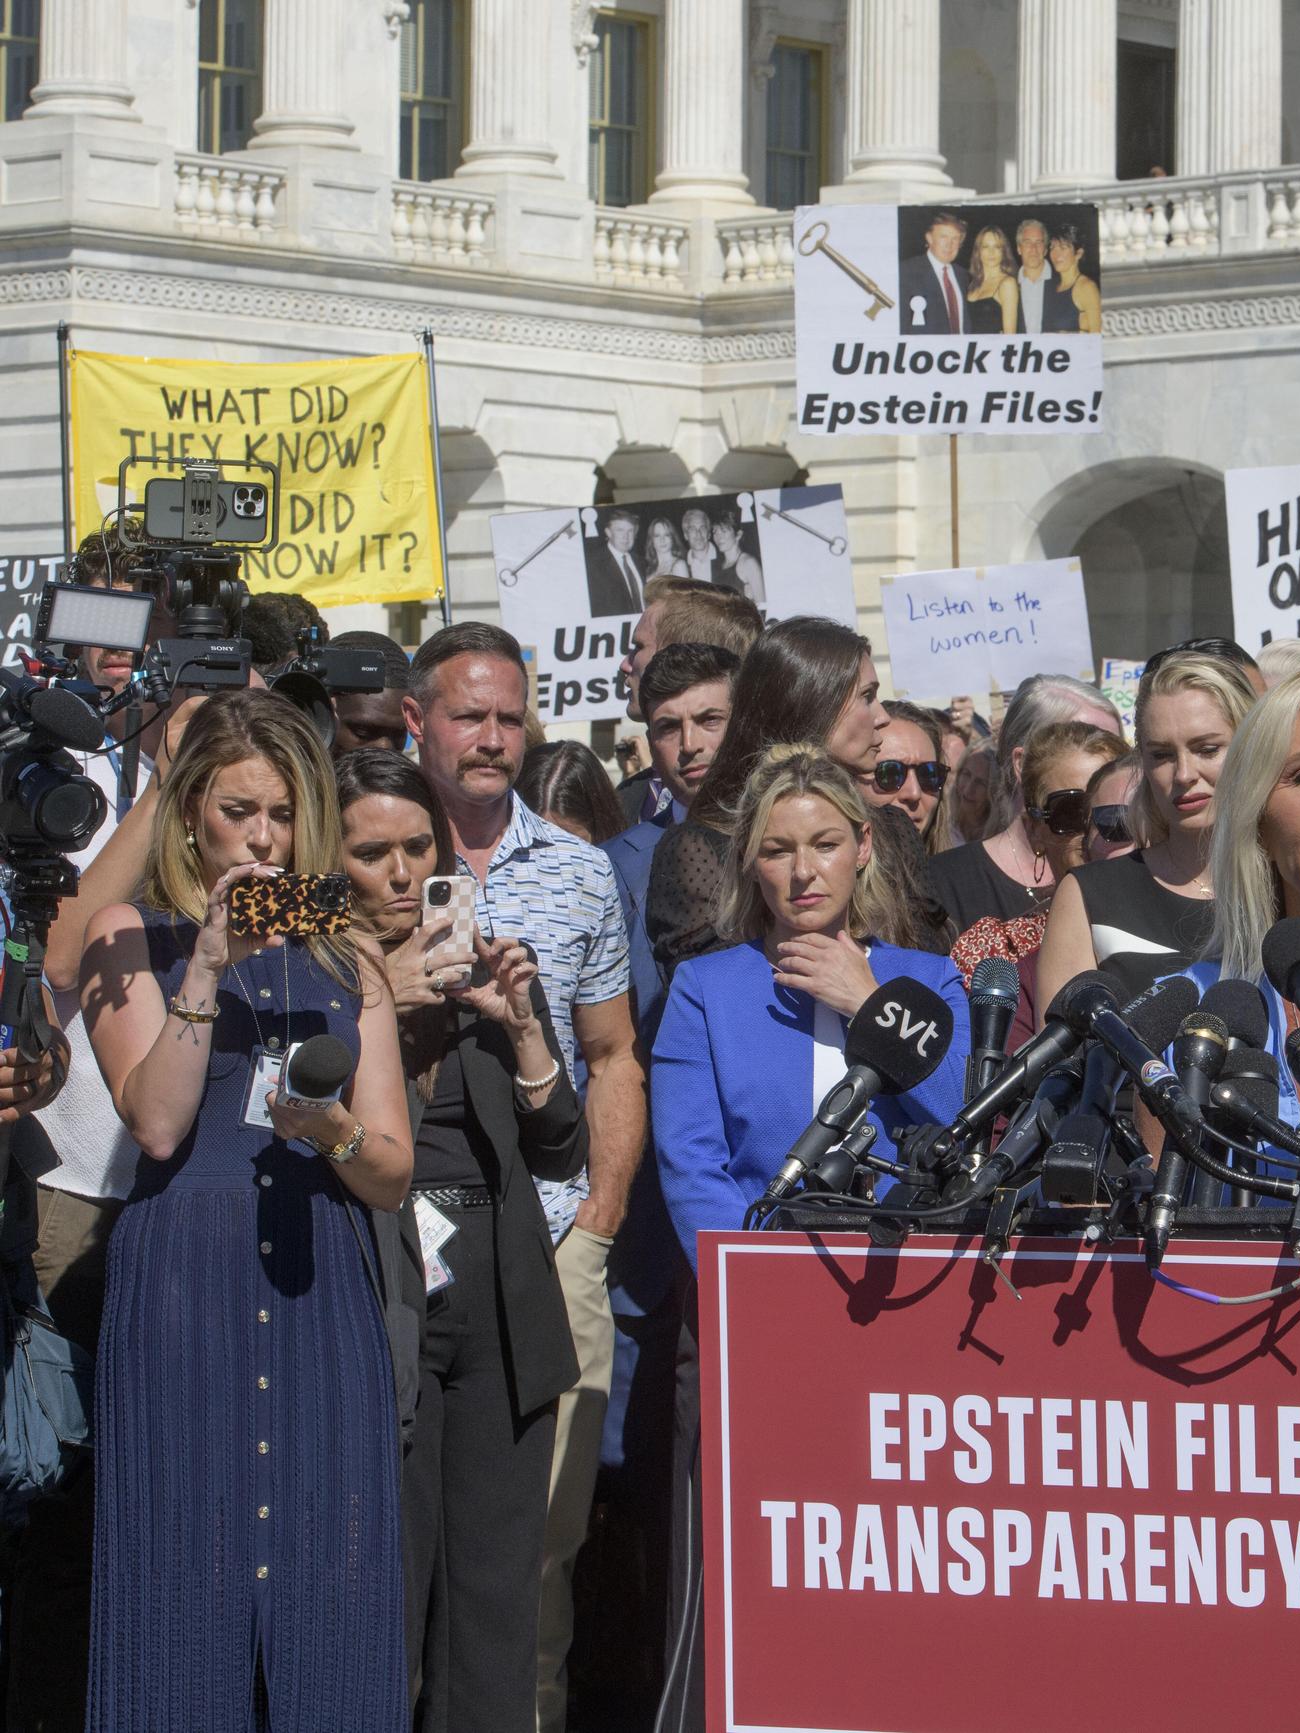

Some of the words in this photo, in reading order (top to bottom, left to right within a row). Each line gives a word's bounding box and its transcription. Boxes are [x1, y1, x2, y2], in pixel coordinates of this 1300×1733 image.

[832, 342, 991, 375] Unlock
[1002, 341, 1070, 374] the
[161, 386, 270, 425] WHAT
[290, 385, 348, 424] DID
[801, 392, 968, 433] Epstein
[980, 390, 1102, 424] Files!
[245, 422, 386, 474] KNOW?
[290, 491, 355, 534] DID
[224, 541, 339, 580] NOW
[360, 532, 417, 573] IT?
[907, 593, 974, 621] Listen
[989, 596, 1004, 612] to
[1014, 591, 1042, 611] the
[875, 1001, 939, 1058] svt
[869, 1392, 1149, 1488] EPSTEIN
